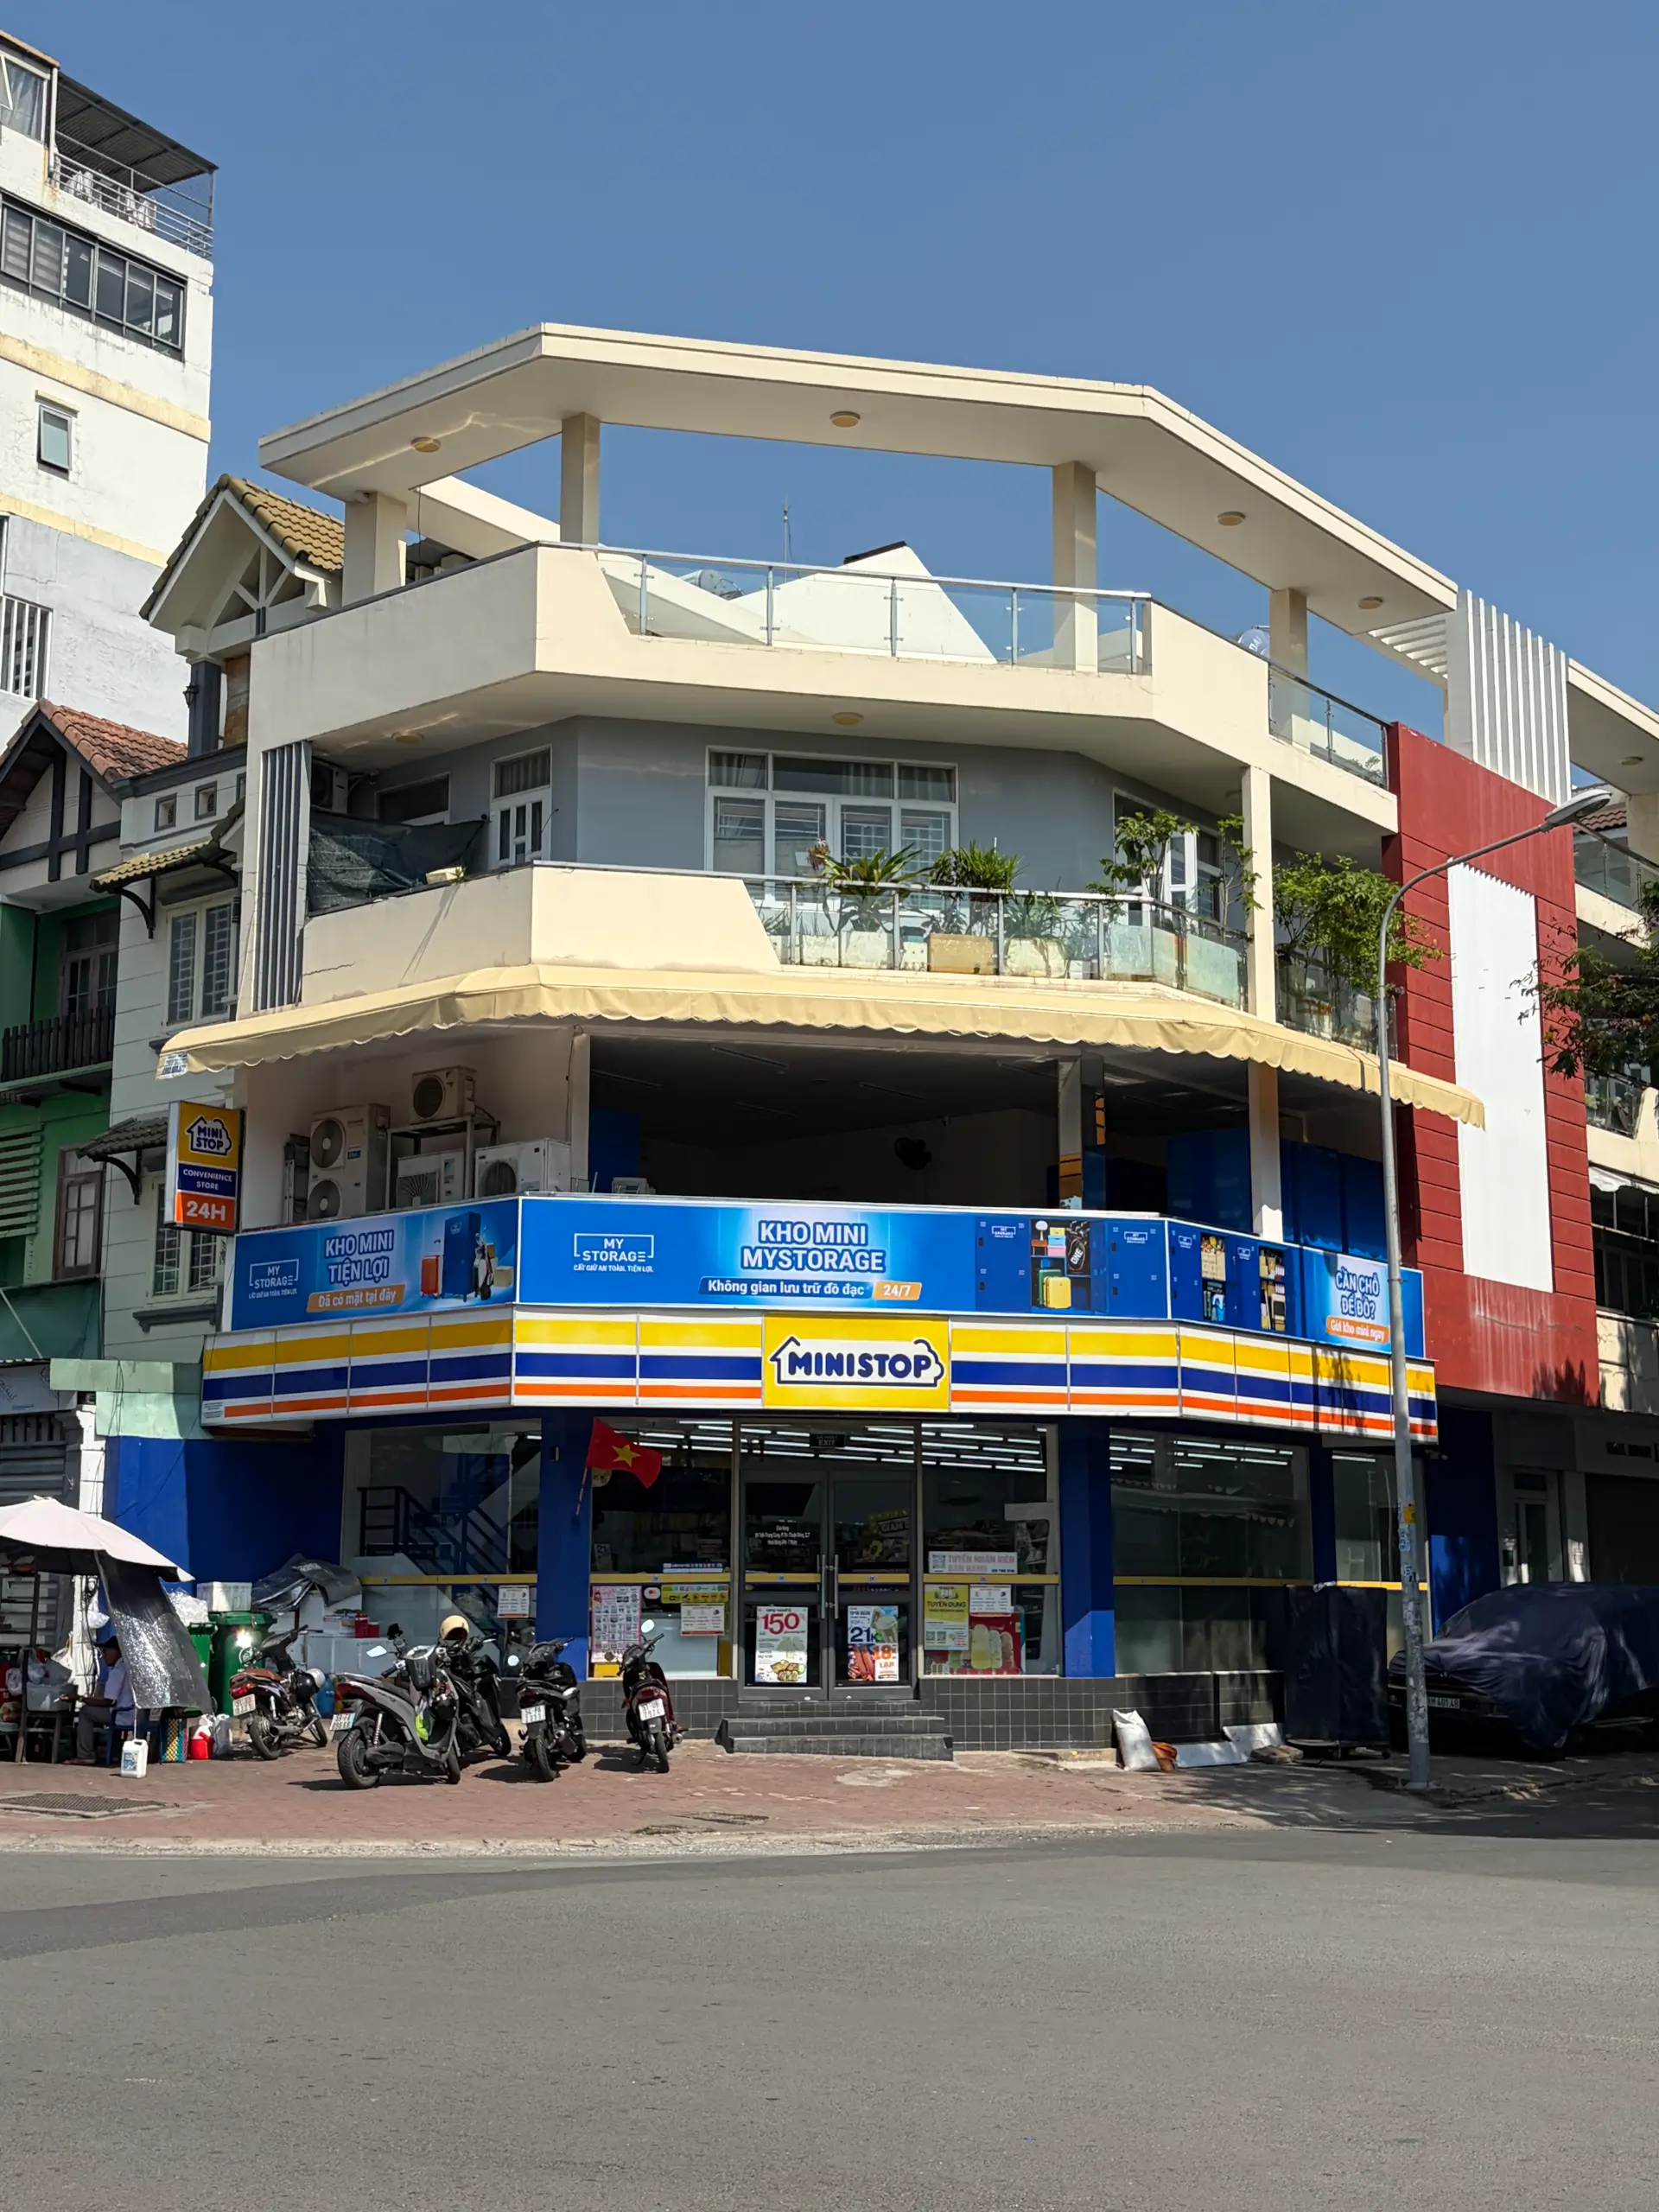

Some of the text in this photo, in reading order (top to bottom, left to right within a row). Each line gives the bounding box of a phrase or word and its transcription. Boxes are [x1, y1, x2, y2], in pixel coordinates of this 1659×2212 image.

[197, 1125, 223, 1138] MINI
[196, 1137, 224, 1150] STOP
[182, 1168, 232, 1182] CONVENIENCE
[196, 1180, 219, 1190] STORE
[186, 1200, 226, 1222] 24H
[760, 1222, 866, 1245] KHO MINI
[325, 1231, 393, 1257] KHO MINI
[604, 1238, 624, 1249] MY
[582, 1250, 646, 1262] STORAGE
[742, 1248, 884, 1271] MYSTORAGE
[1070, 1249, 1084, 1265] ONE
[267, 1265, 281, 1276] MY
[328, 1258, 388, 1286] TIỆN LỢI
[254, 1275, 294, 1289] STORAGE
[709, 1280, 865, 1298] Không gian lưu trữ đồ đạc
[1335, 1267, 1380, 1296] CẦN CHỖ
[318, 1288, 397, 1307] Đã có mặt tại đây
[883, 1285, 912, 1297] 24/7
[1341, 1292, 1356, 1315] ĐỂ
[1342, 1321, 1354, 1334] kho
[1356, 1324, 1370, 1337] mini
[1370, 1328, 1385, 1342] ngay
[788, 1351, 931, 1379] MINISTOP
[760, 1612, 800, 1635] 150
